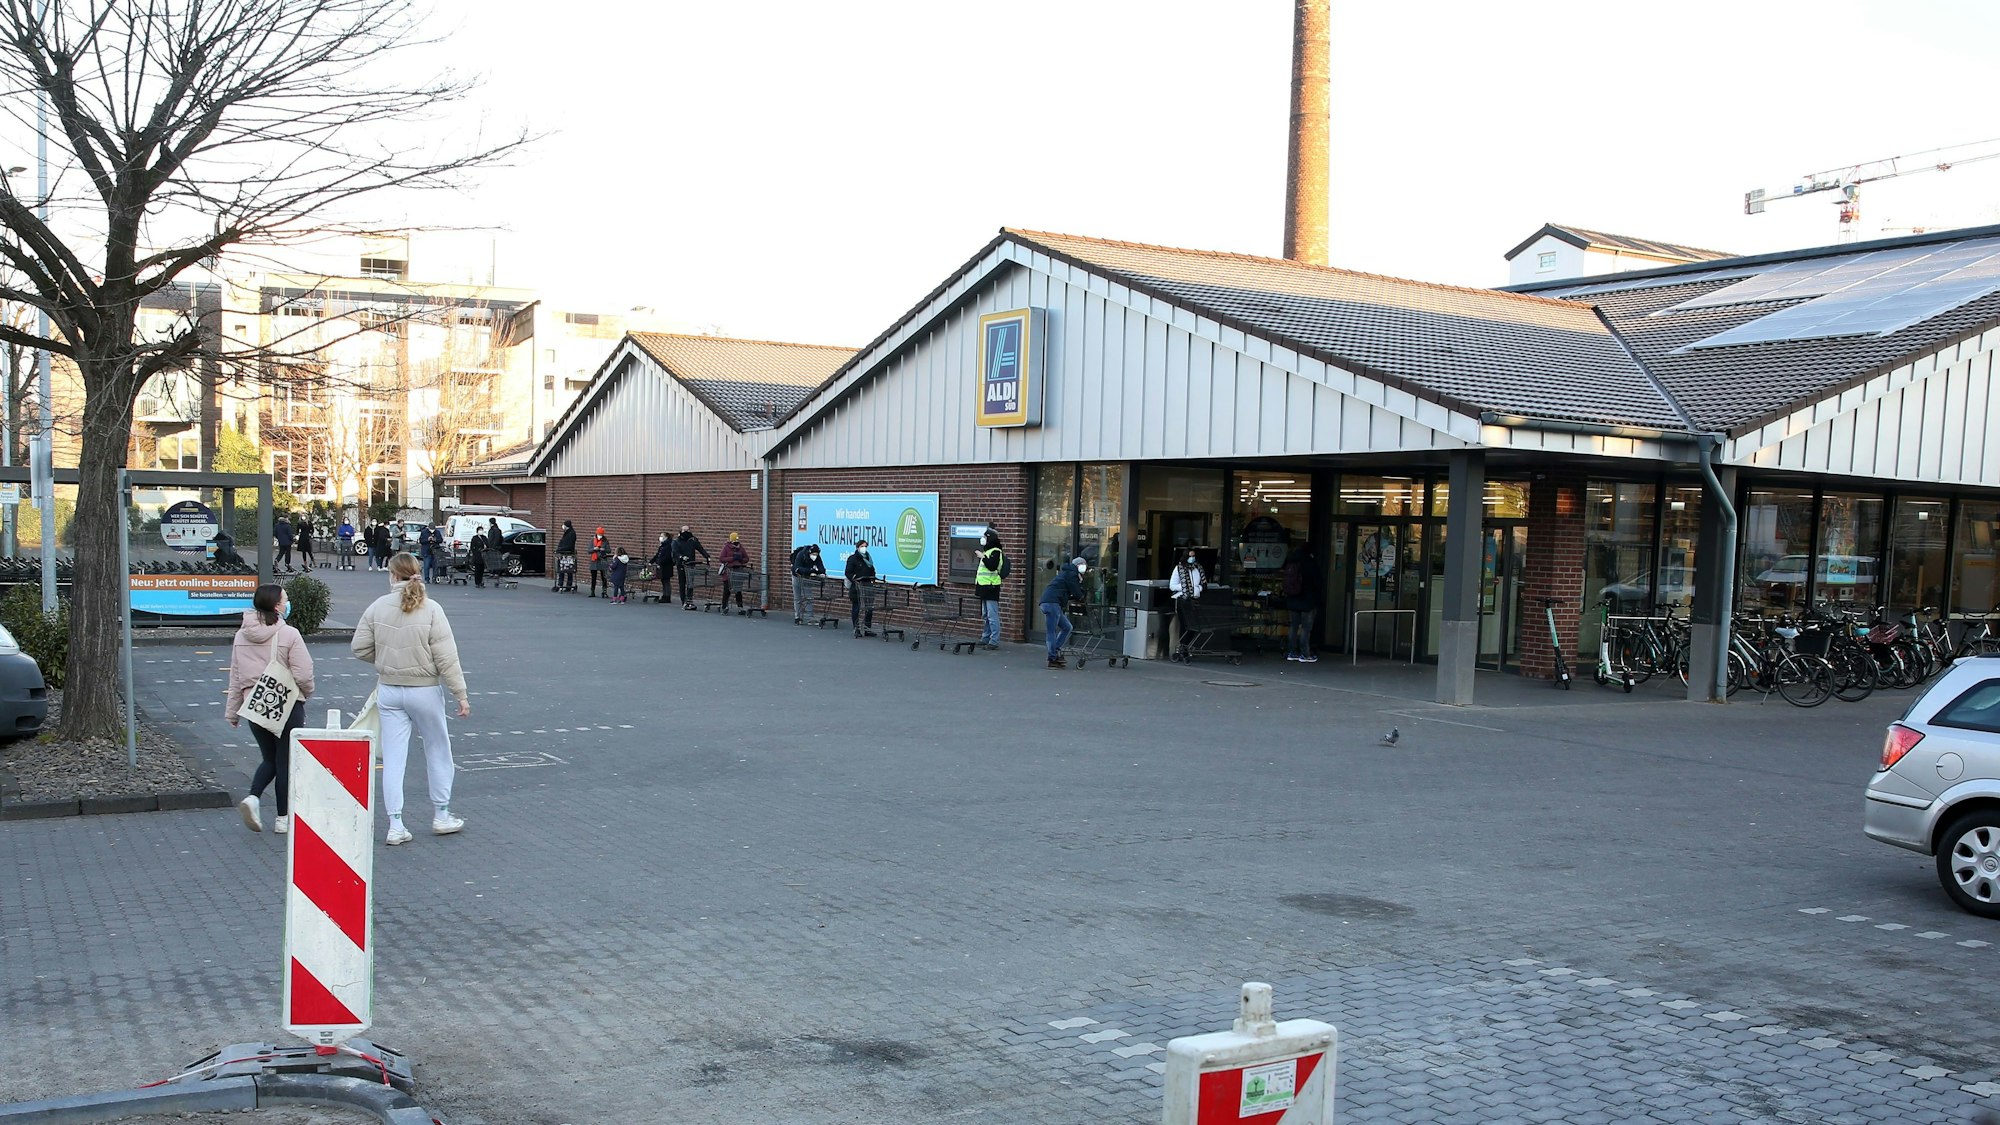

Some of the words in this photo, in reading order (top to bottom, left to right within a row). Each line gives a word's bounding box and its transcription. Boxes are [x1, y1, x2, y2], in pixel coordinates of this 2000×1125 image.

[987, 382, 1016, 401] ALDI
[1004, 400, 1016, 411] SÜD
[835, 508, 845, 519] Wir
[846, 509, 869, 520] handeln
[819, 524, 888, 547] KLIMANEUTRAL
[131, 579, 153, 587] Neu:
[155, 579, 177, 587] Jetzt
[180, 578, 209, 588] online
[212, 579, 255, 588] bezahlen
[253, 684, 287, 714] BOX
